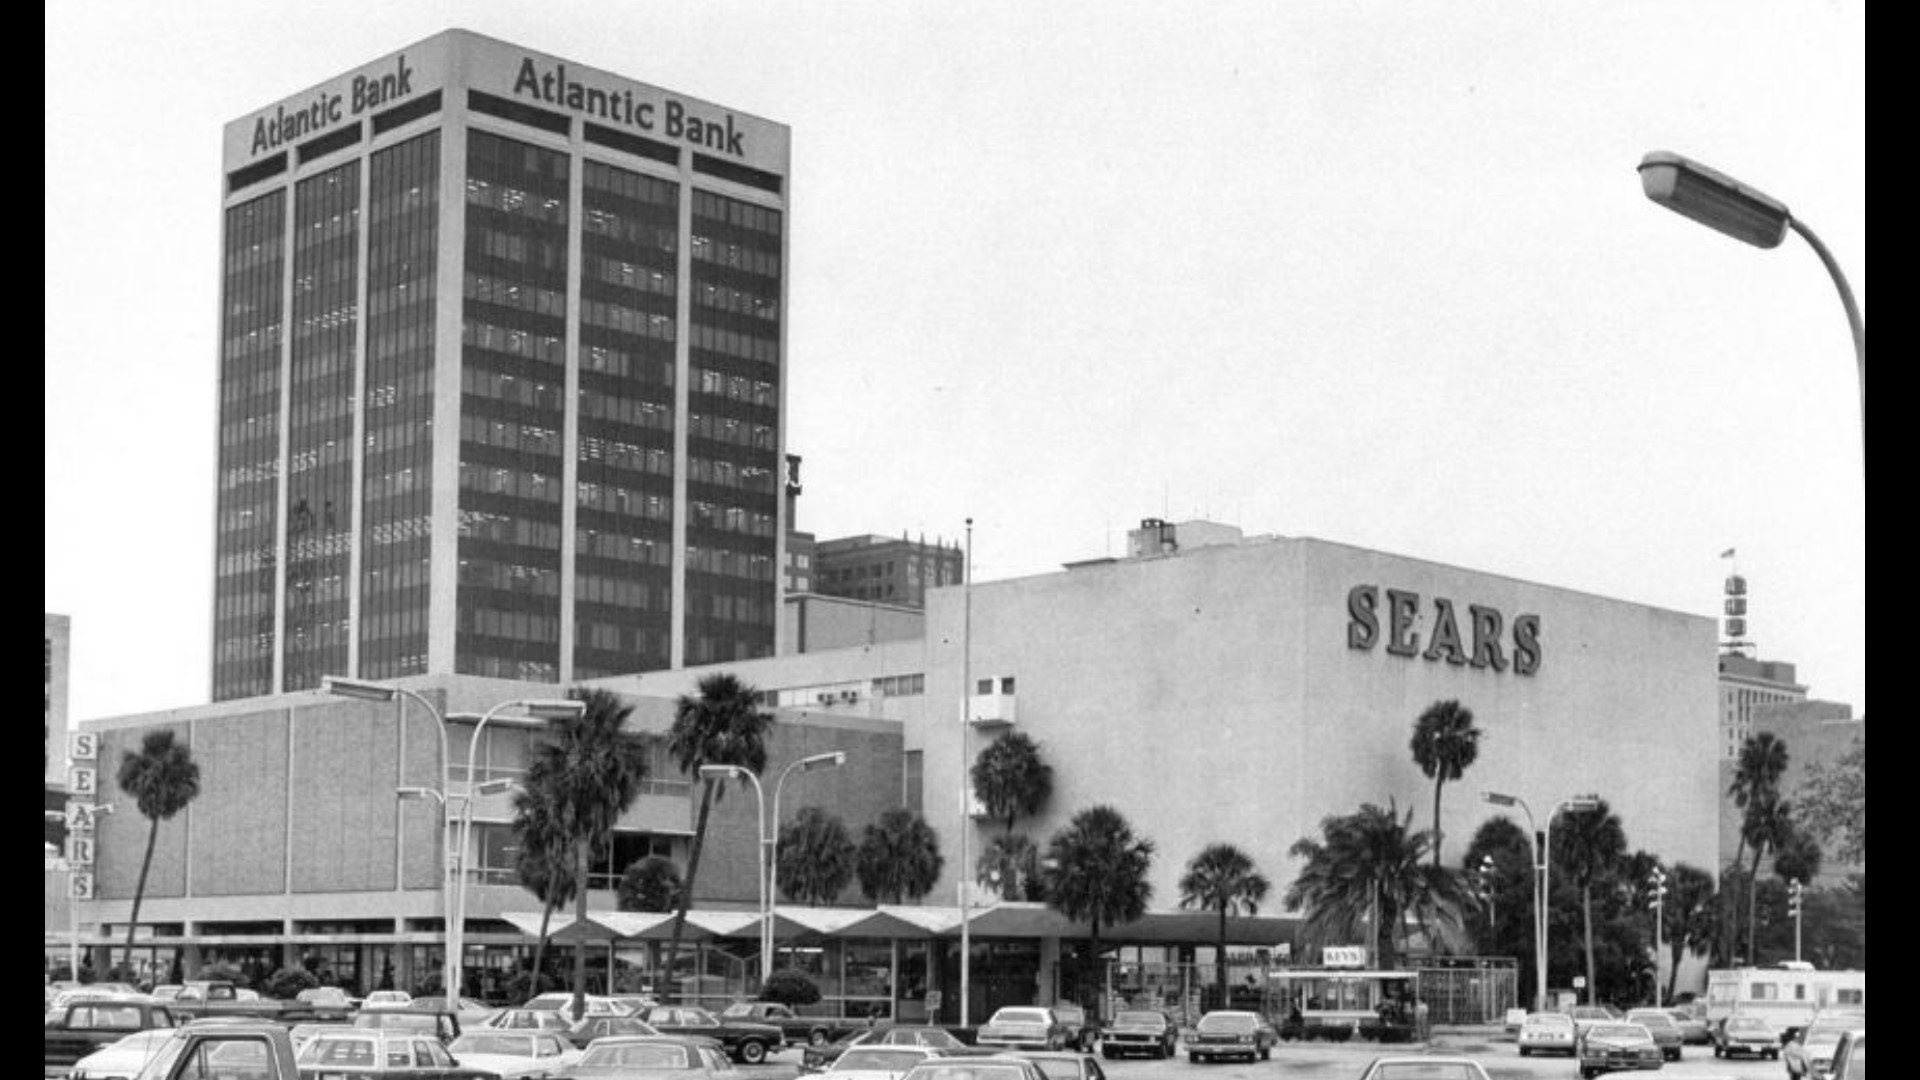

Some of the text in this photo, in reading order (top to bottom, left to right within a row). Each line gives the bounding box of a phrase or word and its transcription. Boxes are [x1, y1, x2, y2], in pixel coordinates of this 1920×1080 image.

[252, 55, 413, 156] Atlantic Bank
[514, 57, 743, 156] Atlantic Bank
[1347, 584, 1542, 677] SEARS
[73, 735, 91, 896] SEARS
